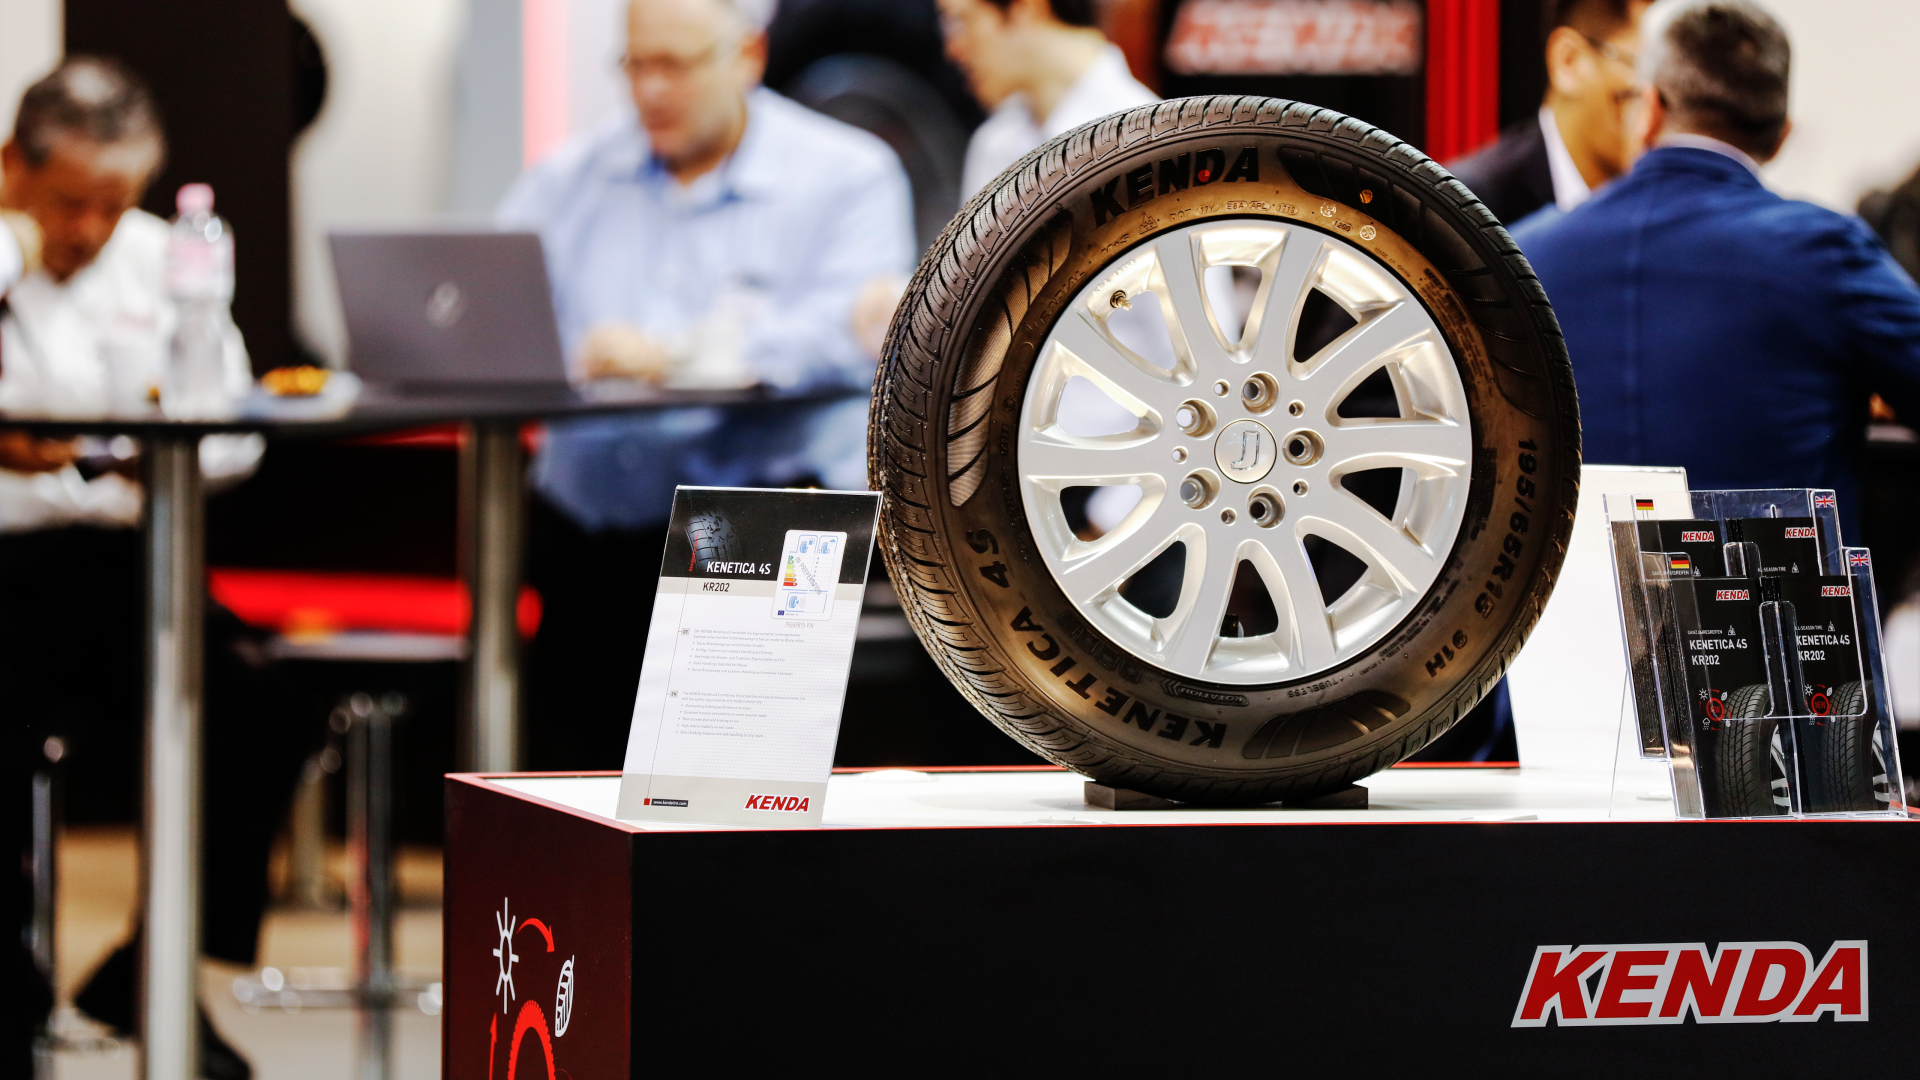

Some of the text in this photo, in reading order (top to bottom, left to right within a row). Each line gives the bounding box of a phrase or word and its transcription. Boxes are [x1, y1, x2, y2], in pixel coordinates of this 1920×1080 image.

[1090, 147, 1259, 228] KENDA
[1170, 208, 1192, 221] DOT
[1250, 201, 1267, 210] APL
[1334, 220, 1352, 232] 1200
[1474, 438, 1538, 619] 195/65R15
[1785, 527, 1816, 538] KENDA
[1682, 531, 1714, 542] KENDA
[706, 560, 771, 574] KENETICA 4S
[702, 582, 730, 592] KR202
[1821, 586, 1851, 596] KENDA
[1716, 589, 1750, 601] KENDA
[966, 528, 1227, 749] KENETICA 4S
[1690, 638, 1748, 650] KENETICA 4S
[1796, 634, 1850, 645] KENETICA 4S
[1424, 629, 1468, 678] 91H
[1798, 650, 1826, 660] KR202
[1691, 655, 1720, 665] KR202
[1287, 677, 1339, 698] TUBELESS
[1180, 687, 1245, 704] ROTATION
[1711, 706, 1720, 714] EW
[744, 794, 810, 812] KENDA
[1511, 940, 1869, 1028] KENDA
